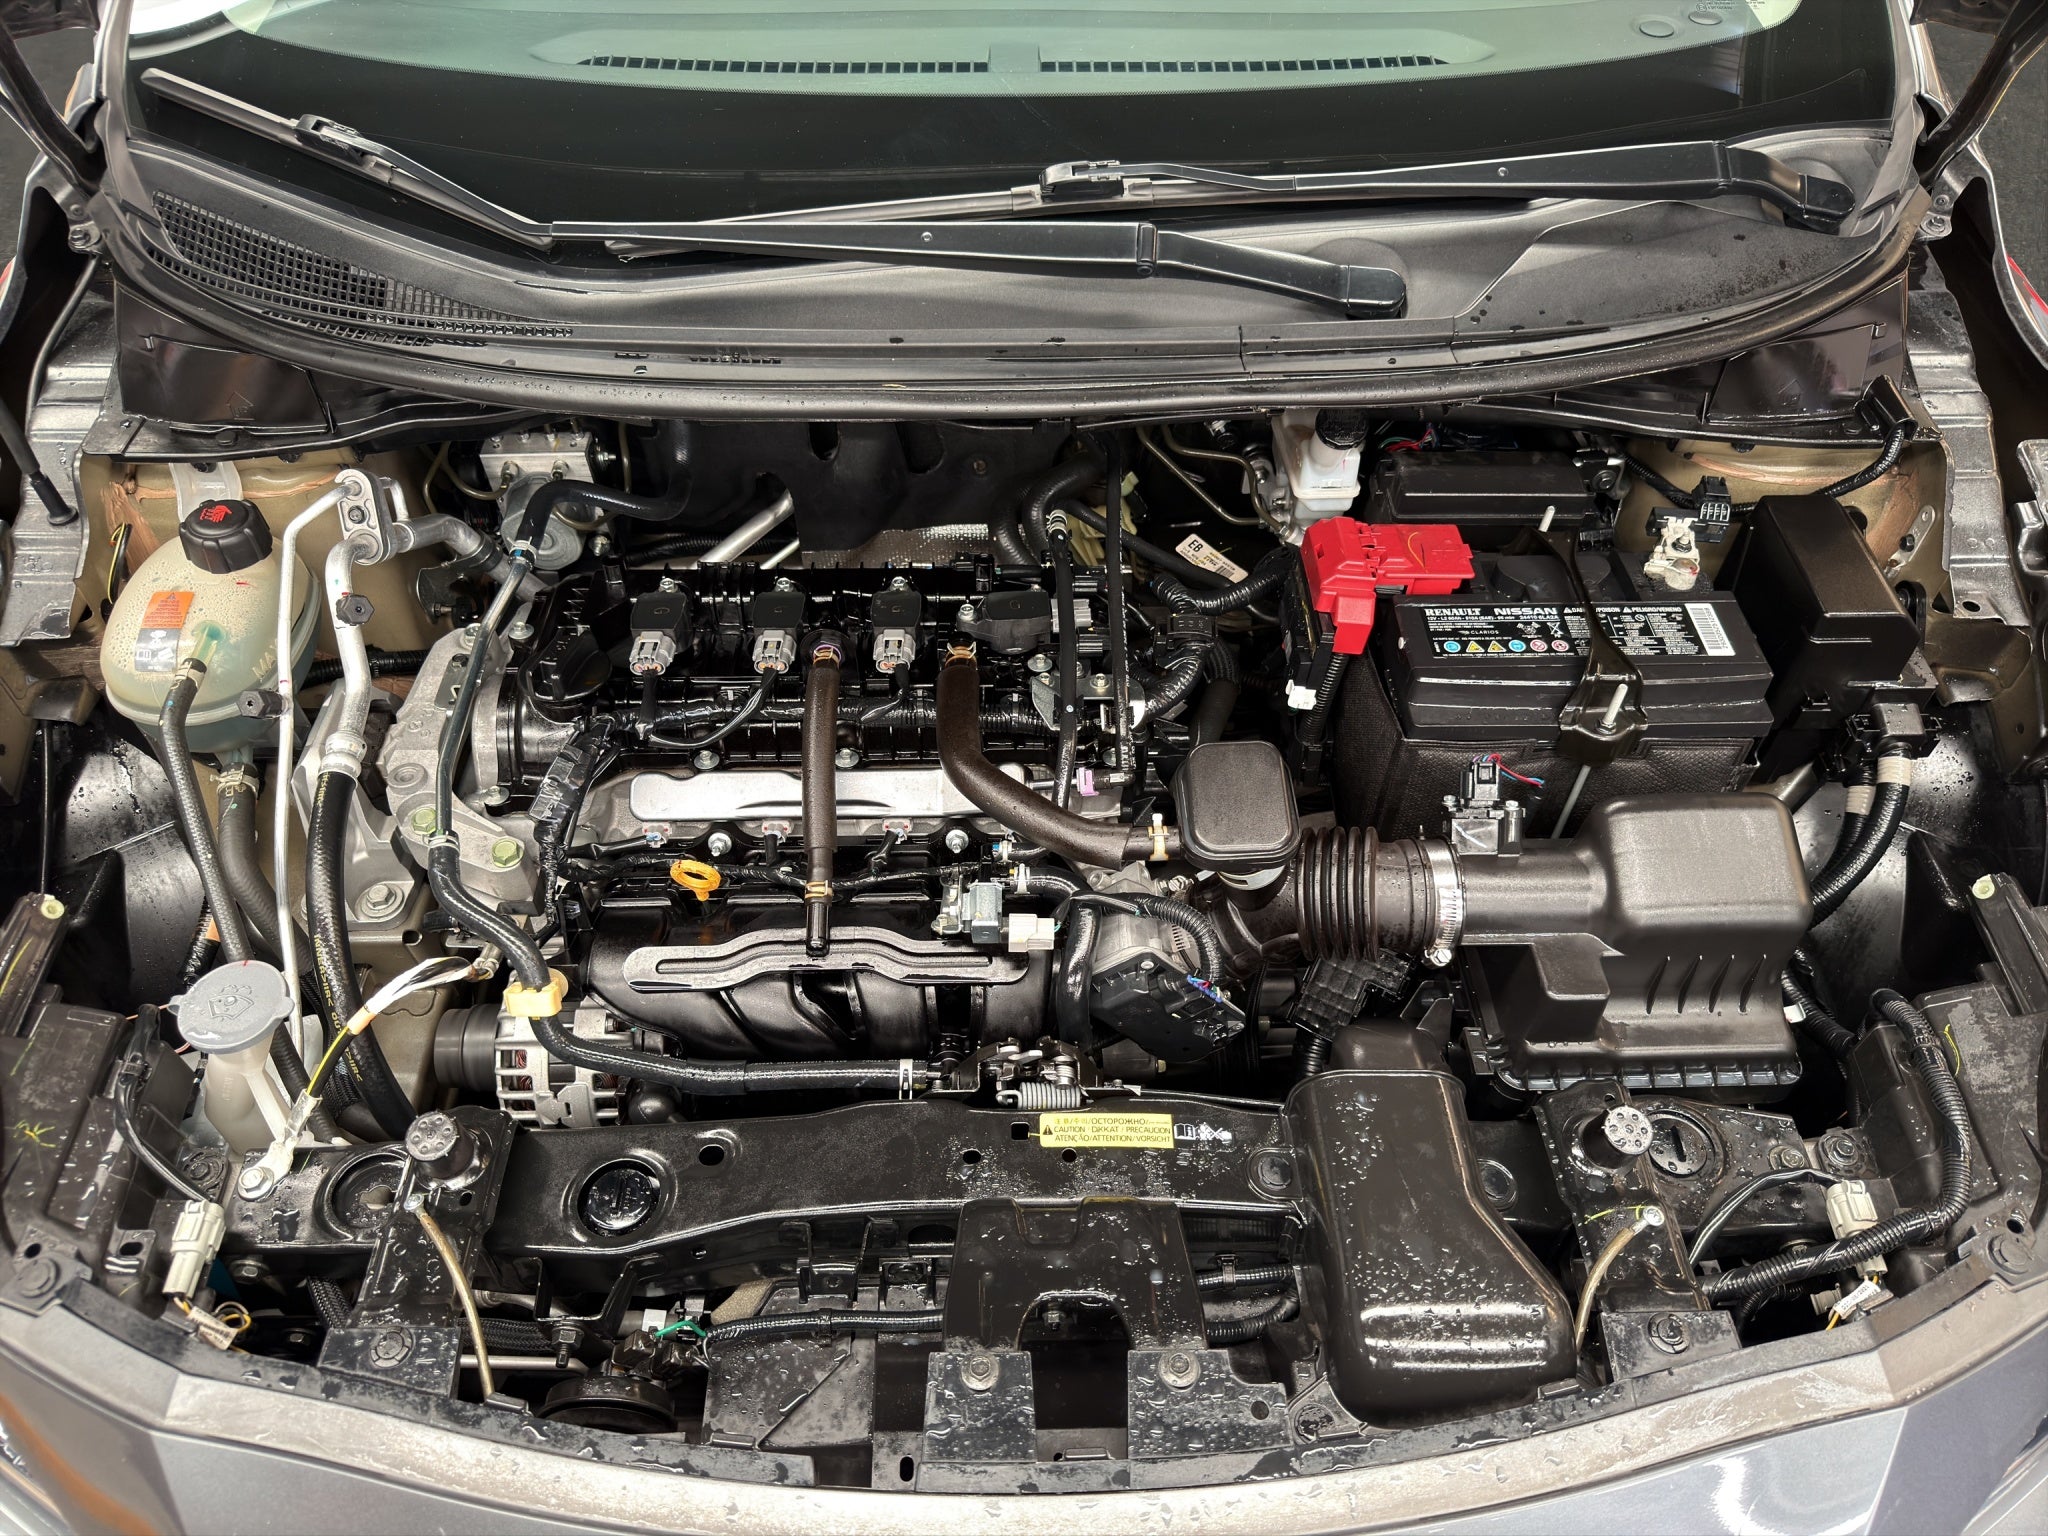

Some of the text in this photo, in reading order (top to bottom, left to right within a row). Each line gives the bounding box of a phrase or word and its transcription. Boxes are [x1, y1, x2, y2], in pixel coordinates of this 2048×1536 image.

[1188, 539, 1204, 552] EB
[1424, 607, 1558, 616] RENAULT NISSAN
